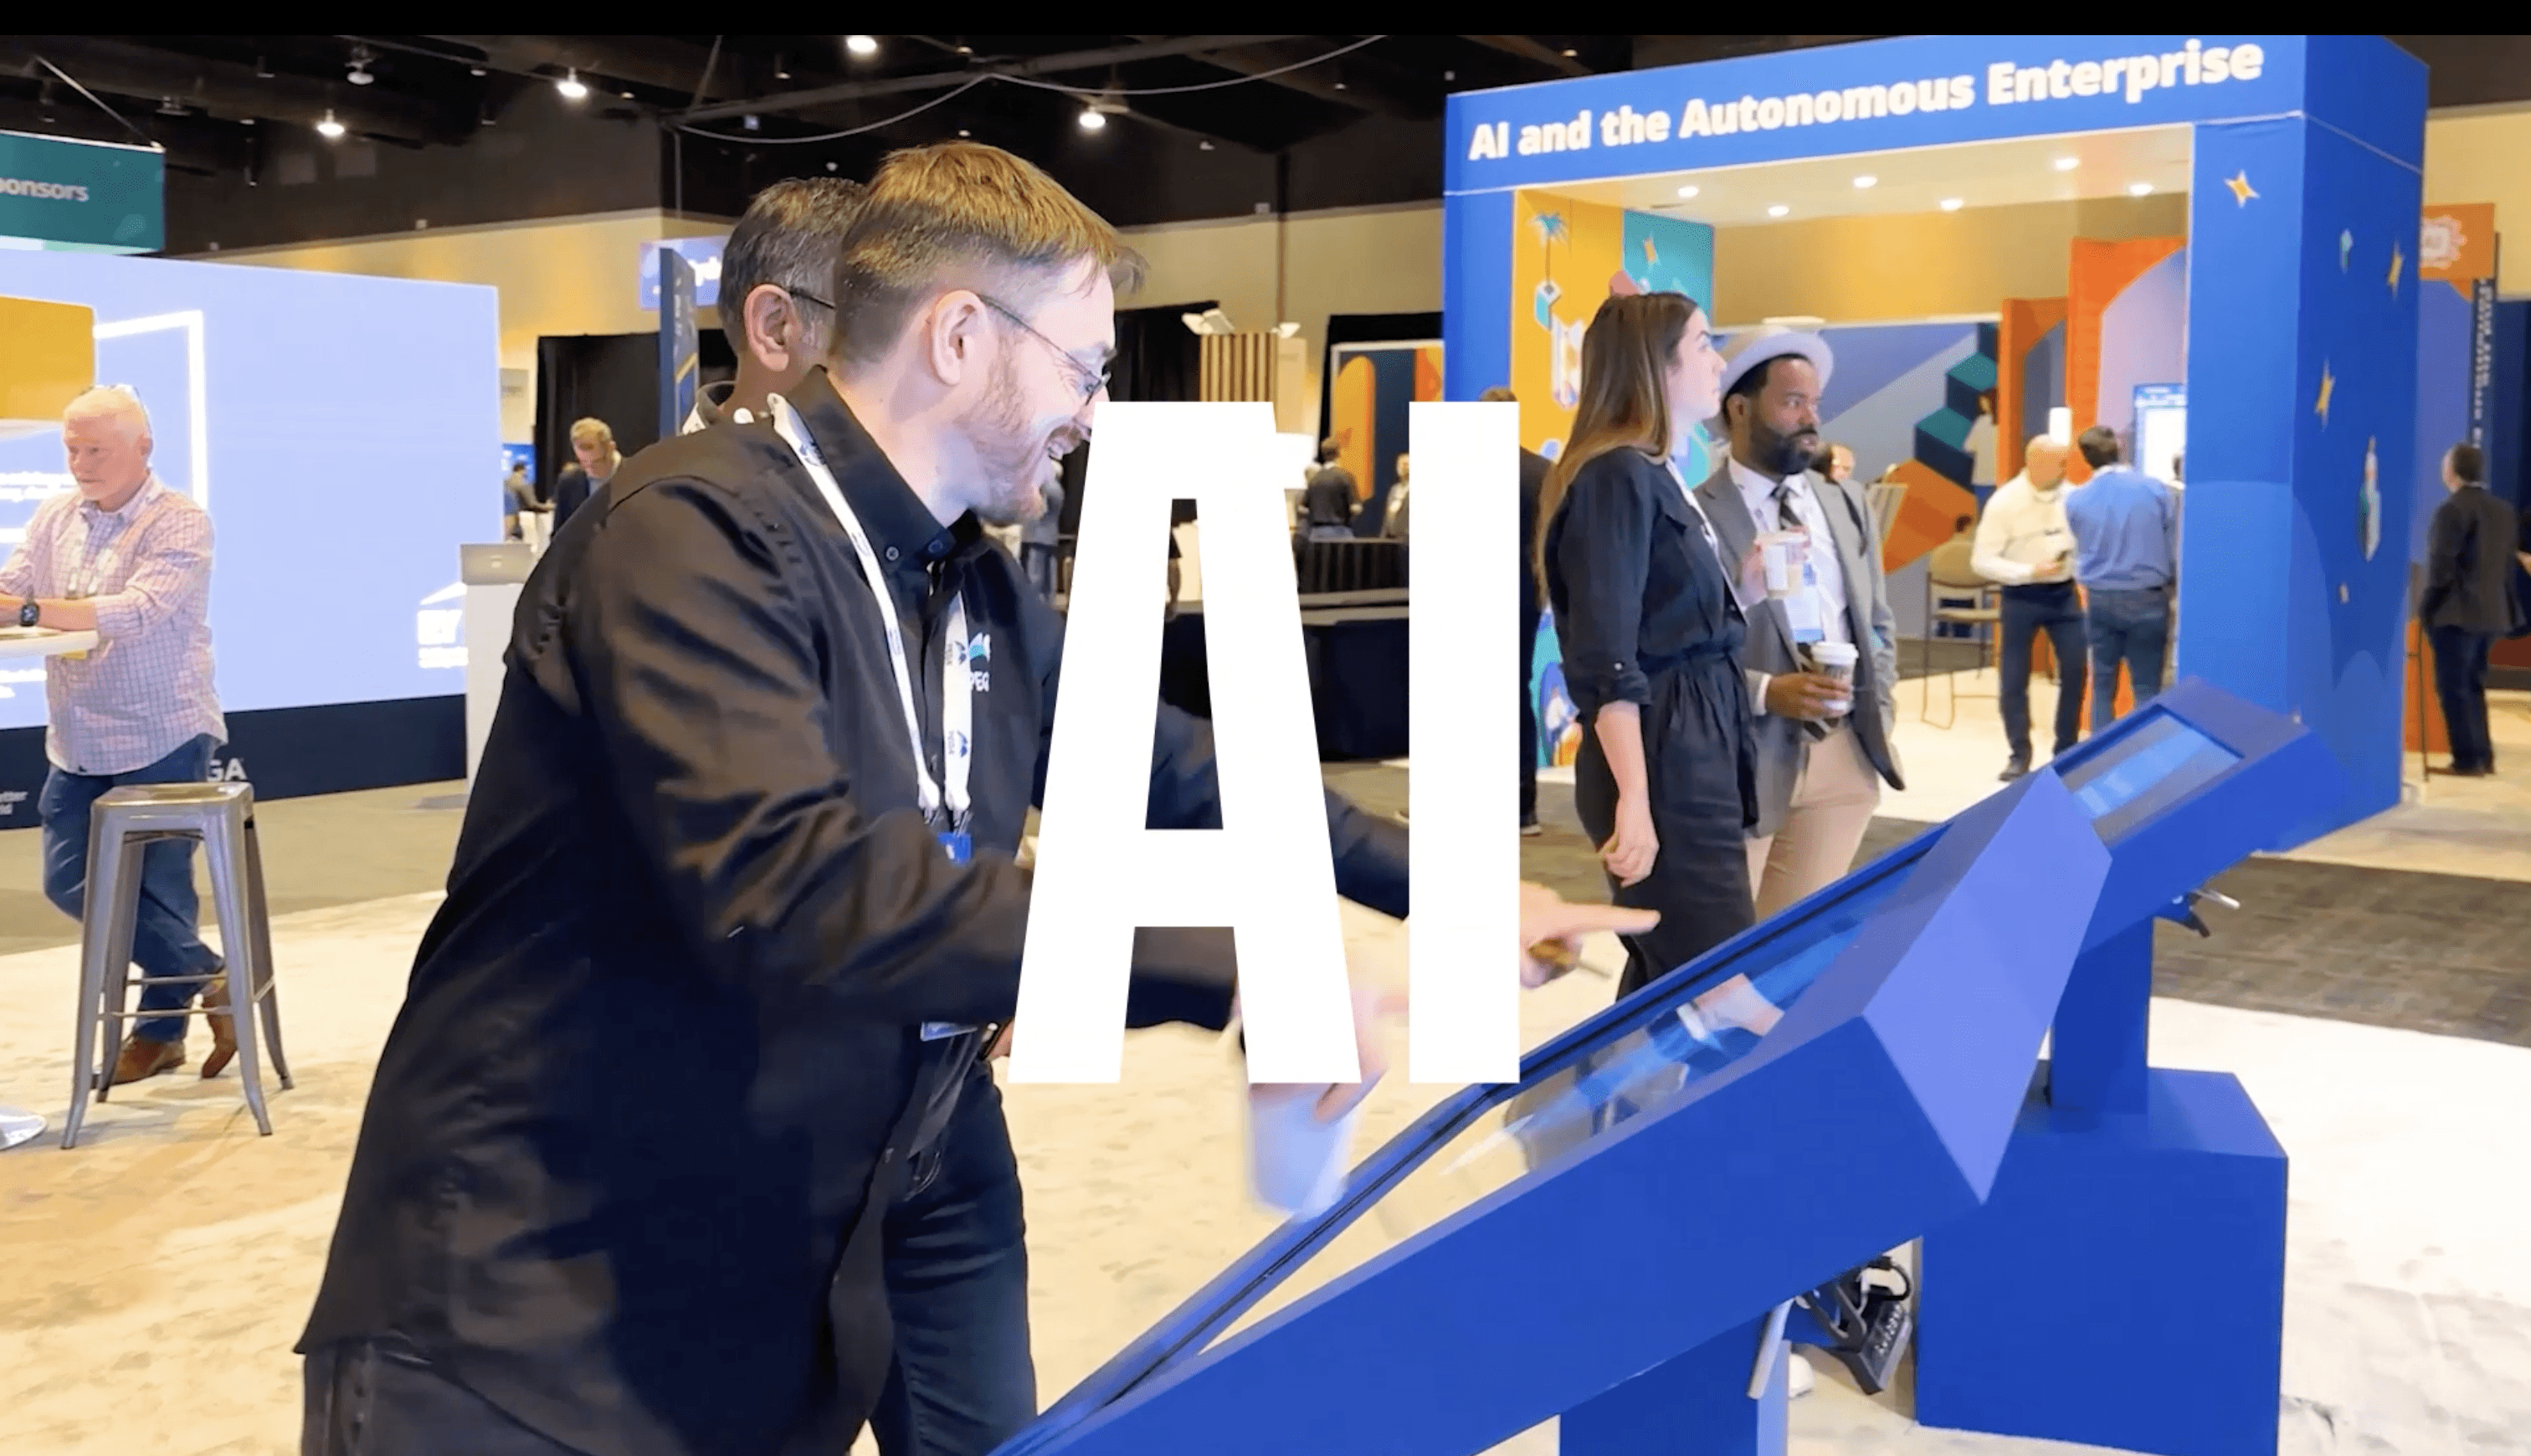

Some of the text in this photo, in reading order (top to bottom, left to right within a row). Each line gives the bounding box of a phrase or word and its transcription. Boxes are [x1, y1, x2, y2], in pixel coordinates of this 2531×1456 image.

[1468, 38, 2264, 161] AI and the Autonomous Enterprise
